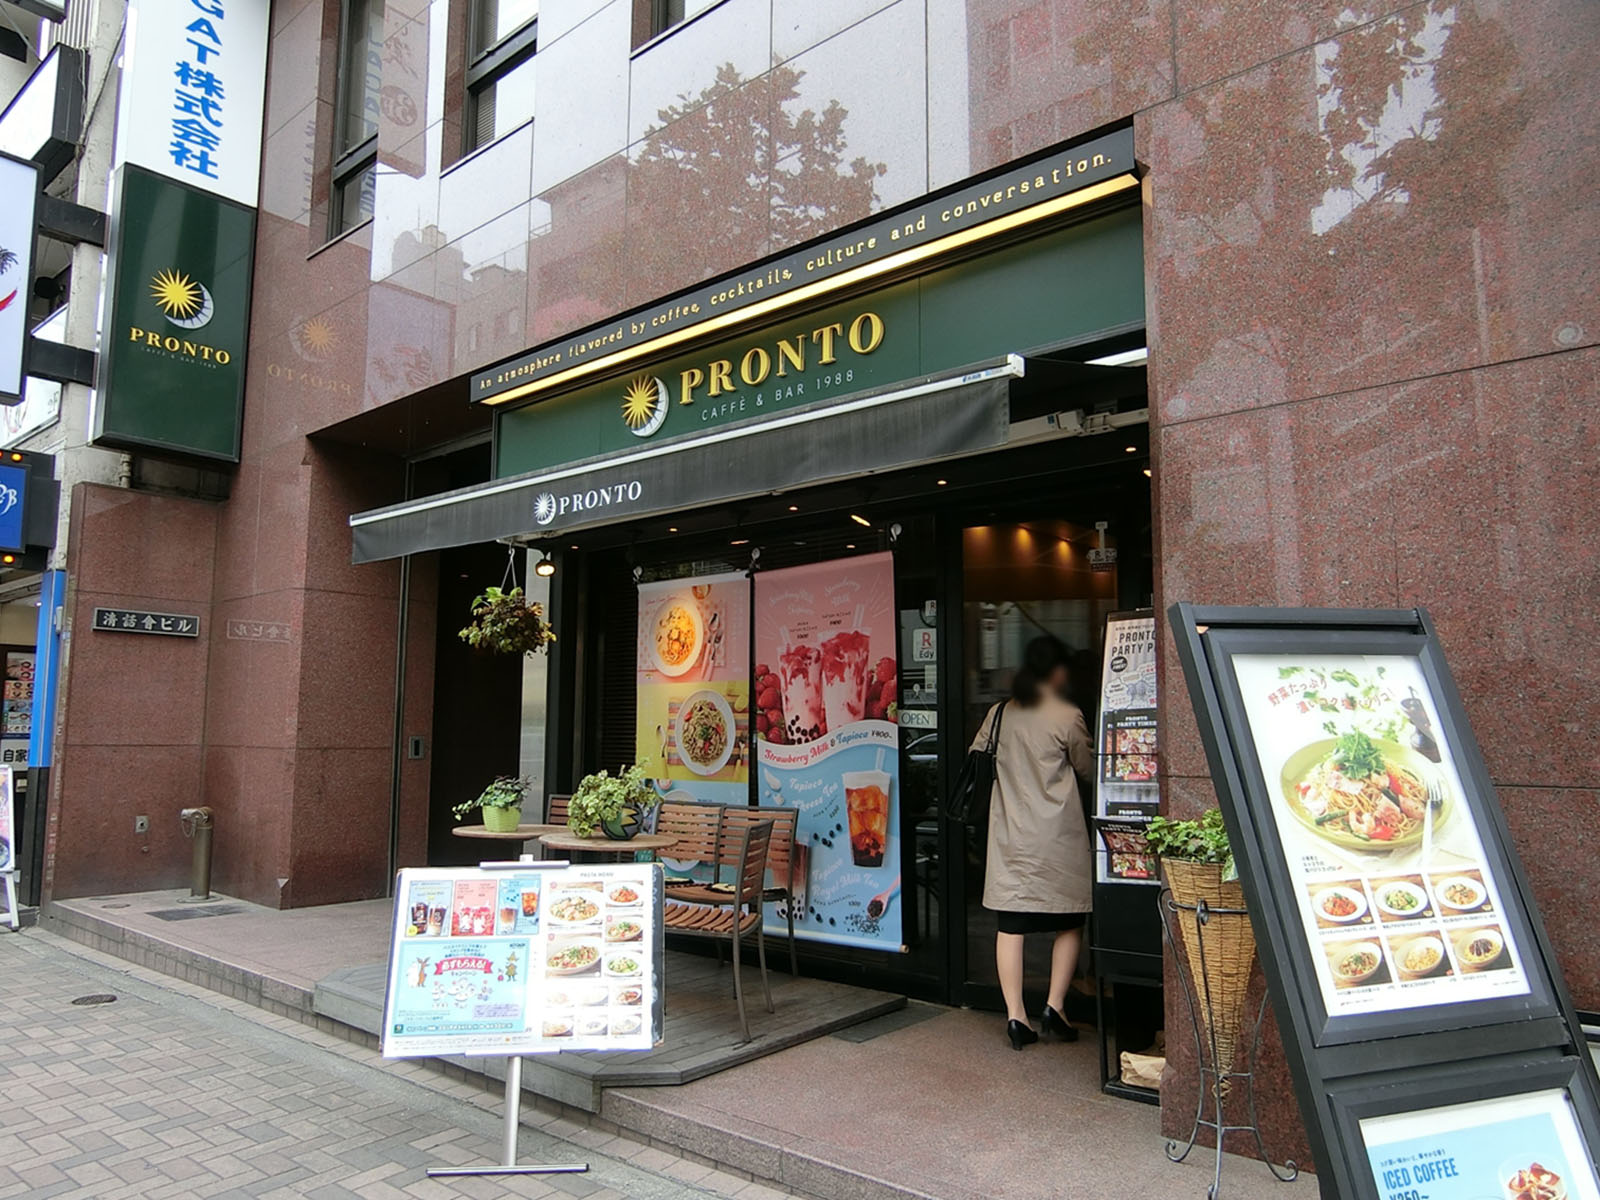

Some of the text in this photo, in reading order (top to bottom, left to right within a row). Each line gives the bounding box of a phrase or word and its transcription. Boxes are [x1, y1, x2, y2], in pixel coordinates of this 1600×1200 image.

[479, 152, 1113, 390] An atmosphere flavored by coffee, cocktails, culture and conversation.
[129, 326, 231, 365] PRONTO
[678, 312, 886, 406] PRONTO
[701, 369, 854, 421] CAFFÈ & BAR 1988
[558, 480, 642, 516] PRONTO
[919, 649, 935, 660] Edy
[1111, 643, 1144, 657] PARTY
[1267, 677, 1328, 706] 野菜たっぷり
[901, 712, 931, 725] OPEN
[764, 749, 809, 765] Strawberry
[809, 742, 829, 758] Milk
[836, 729, 869, 744] Tapioca
[1382, 1157, 1459, 1191] ICED COFFEE
